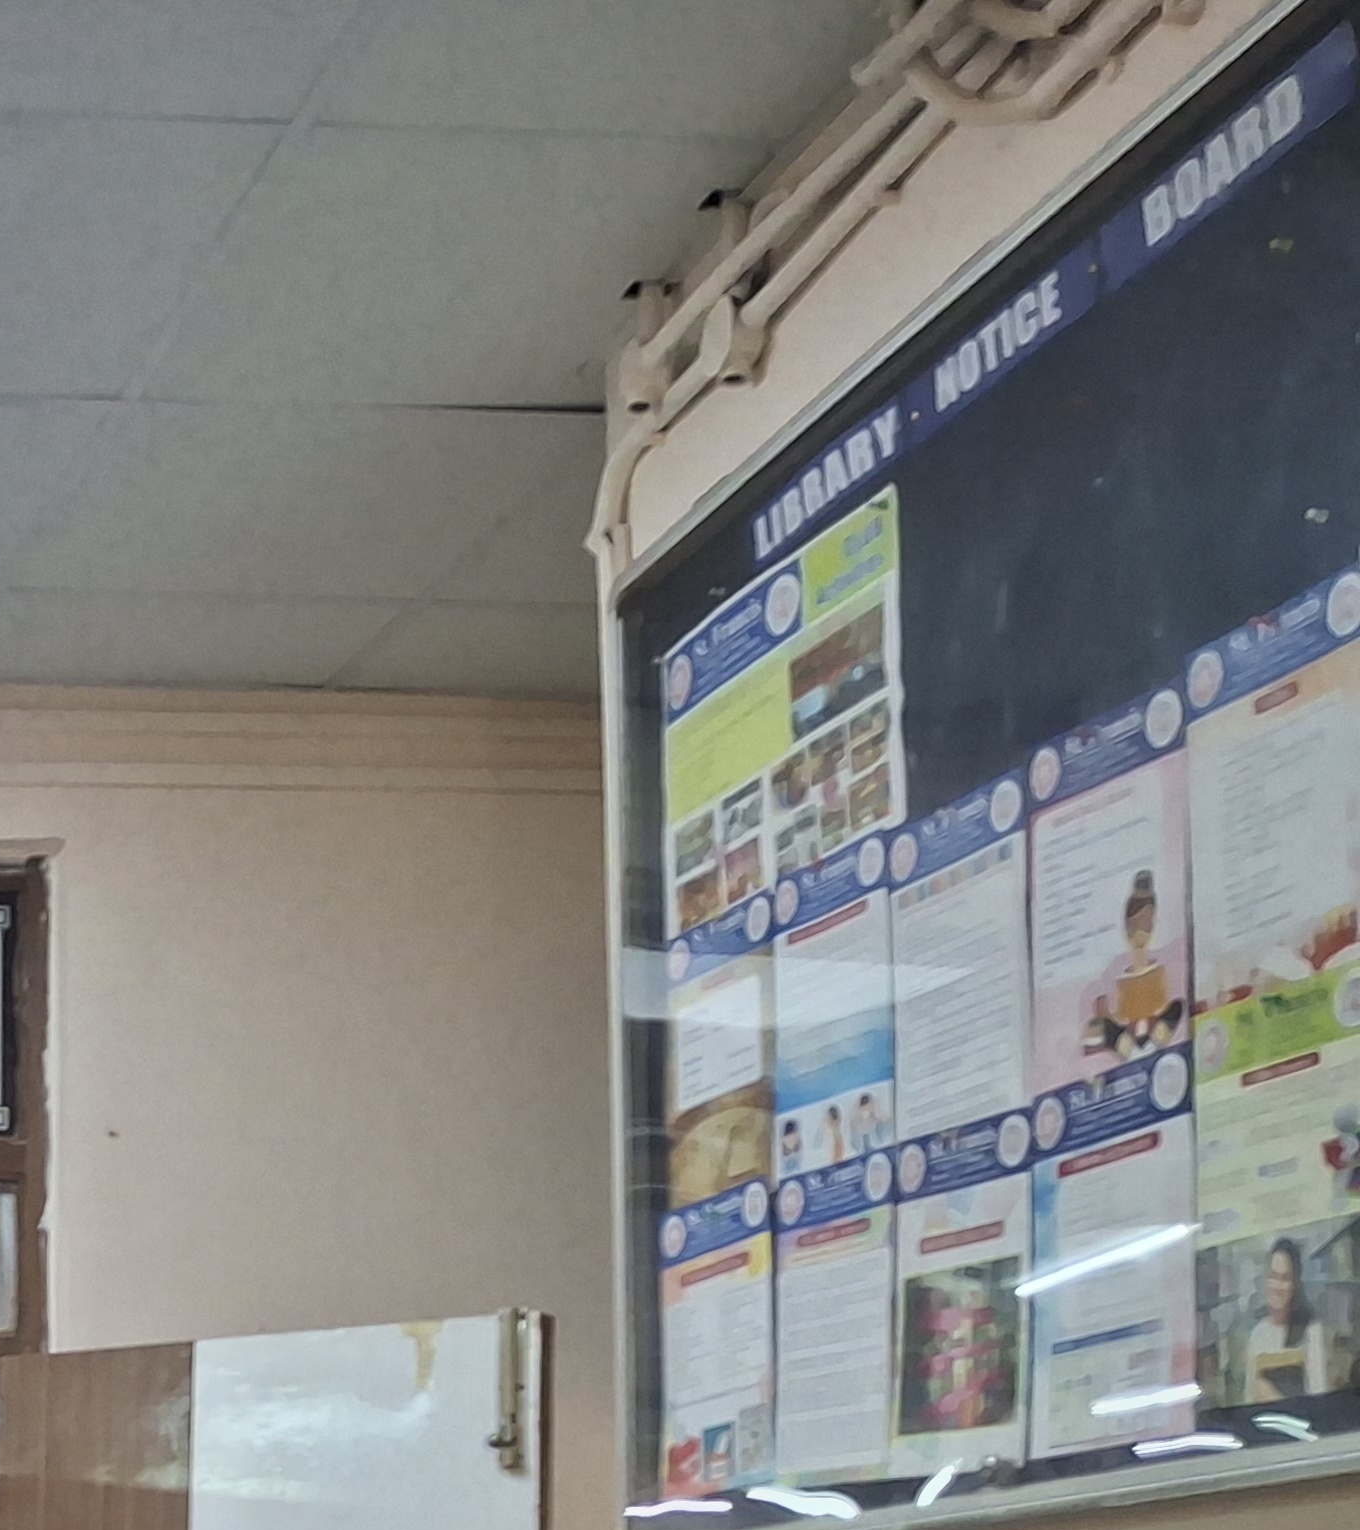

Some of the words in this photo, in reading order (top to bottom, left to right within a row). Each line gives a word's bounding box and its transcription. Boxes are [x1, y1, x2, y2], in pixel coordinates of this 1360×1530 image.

[753, 404, 901, 561] LIBRARY
[934, 271, 1063, 413] NOTICE
[1141, 75, 1303, 247] BOARD
